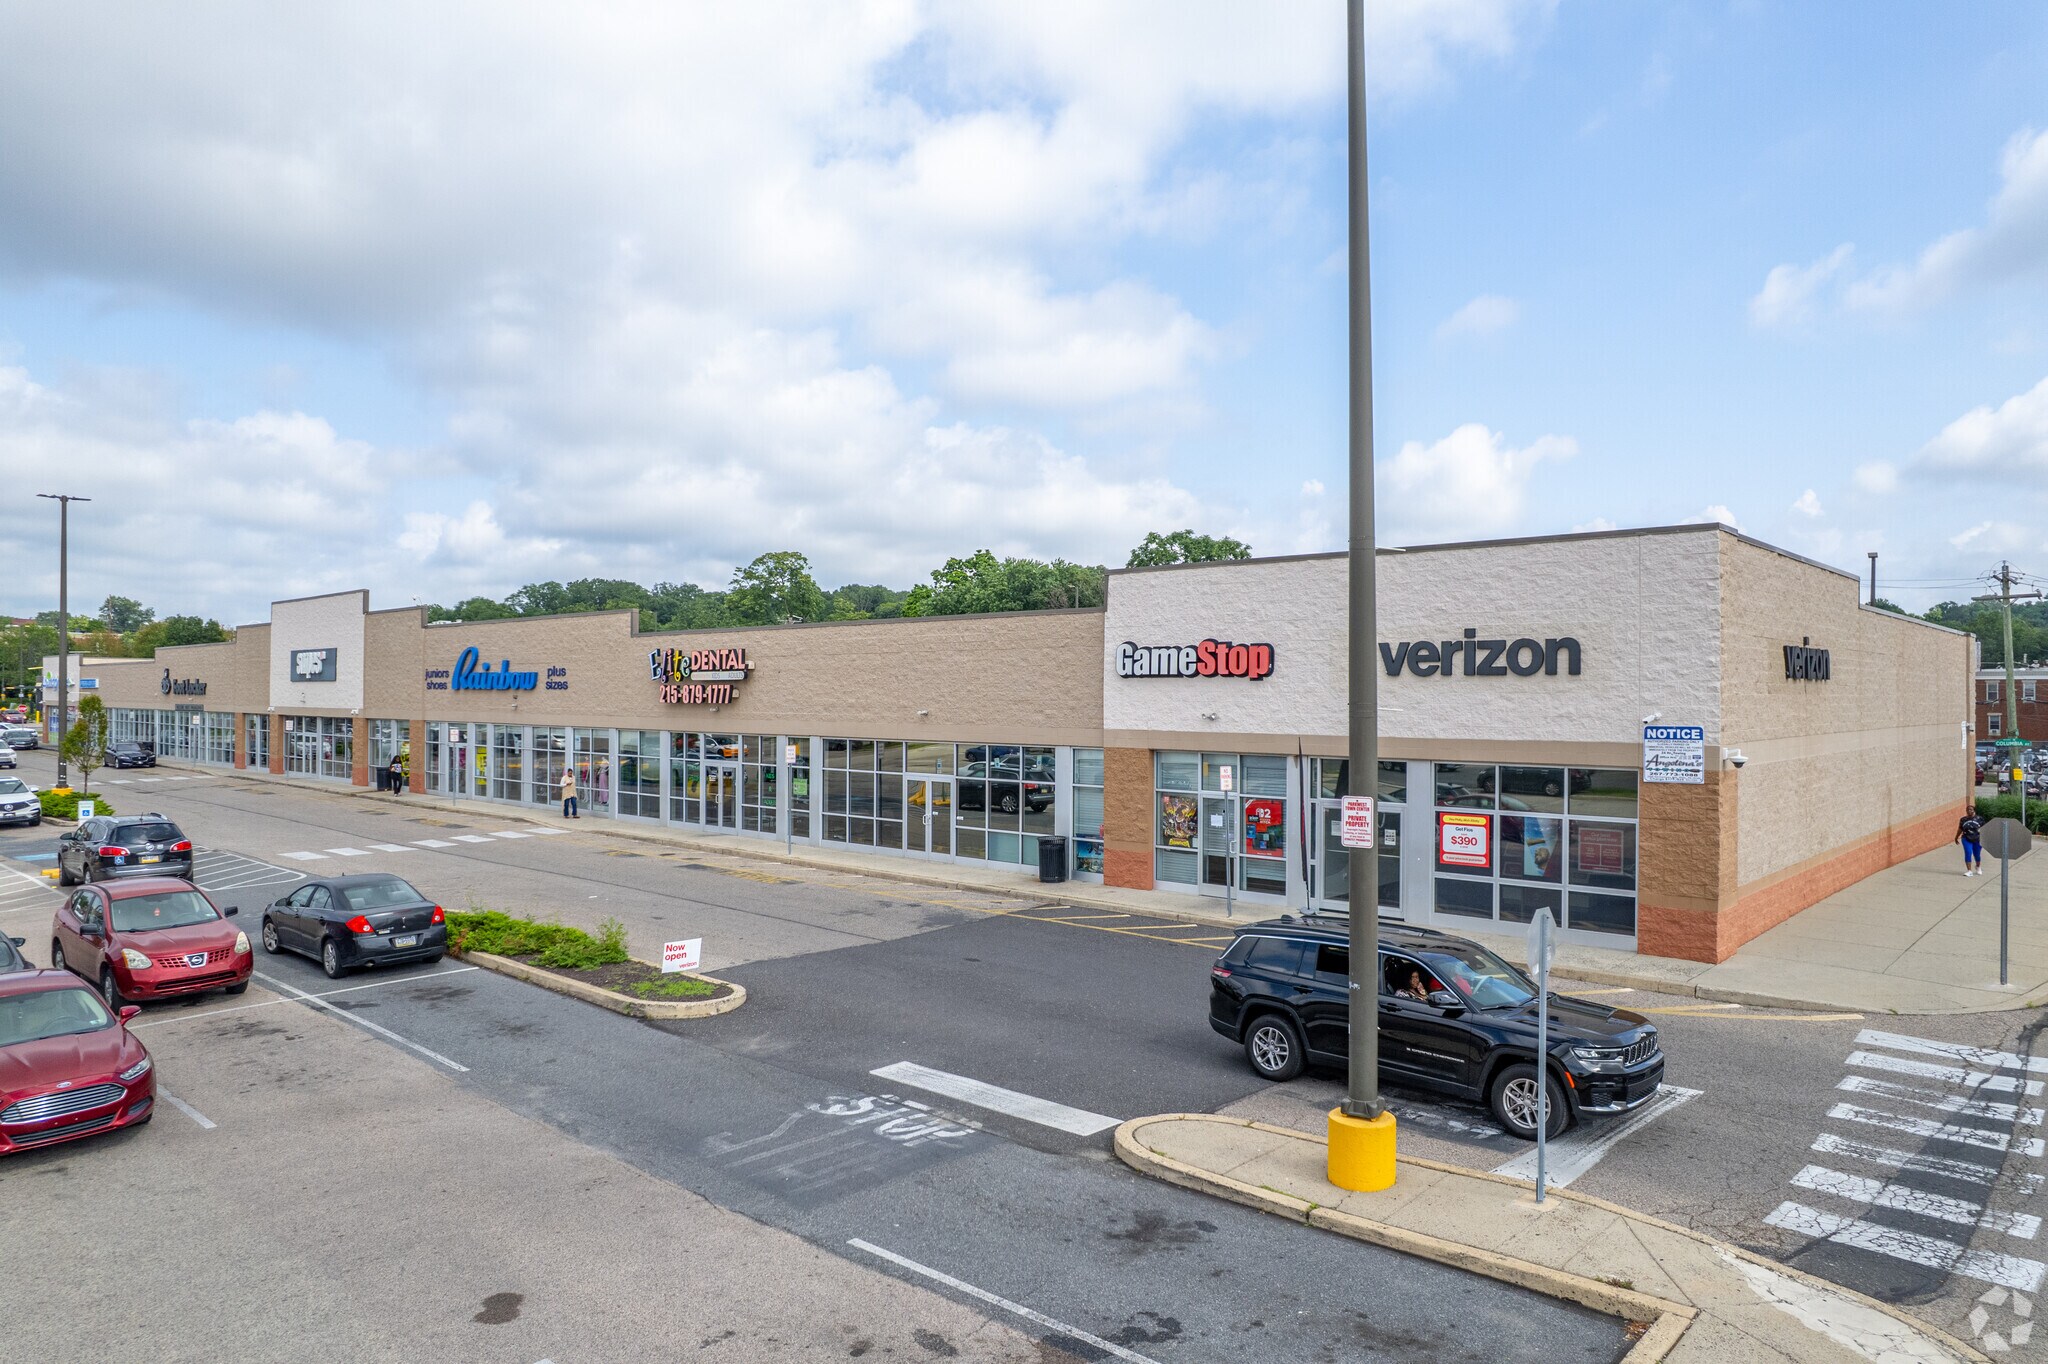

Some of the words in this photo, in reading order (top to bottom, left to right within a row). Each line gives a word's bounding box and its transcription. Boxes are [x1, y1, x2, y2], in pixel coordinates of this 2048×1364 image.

[1378, 628, 1581, 677] verizon
[1783, 636, 1830, 681] verizon
[648, 649, 690, 683] Elite
[691, 649, 745, 671] DENTAL
[1116, 640, 1273, 680] GameStop
[425, 668, 449, 681] juniors
[451, 646, 538, 690] Rainbow
[547, 665, 566, 678] plus
[426, 680, 447, 690] shoes
[545, 679, 568, 690] sizes
[659, 684, 732, 704] 215-879-1777
[1646, 728, 1700, 739] NOTICE
[1451, 836, 1478, 846] $390
[666, 944, 685, 952] Now
[665, 952, 687, 961] open
